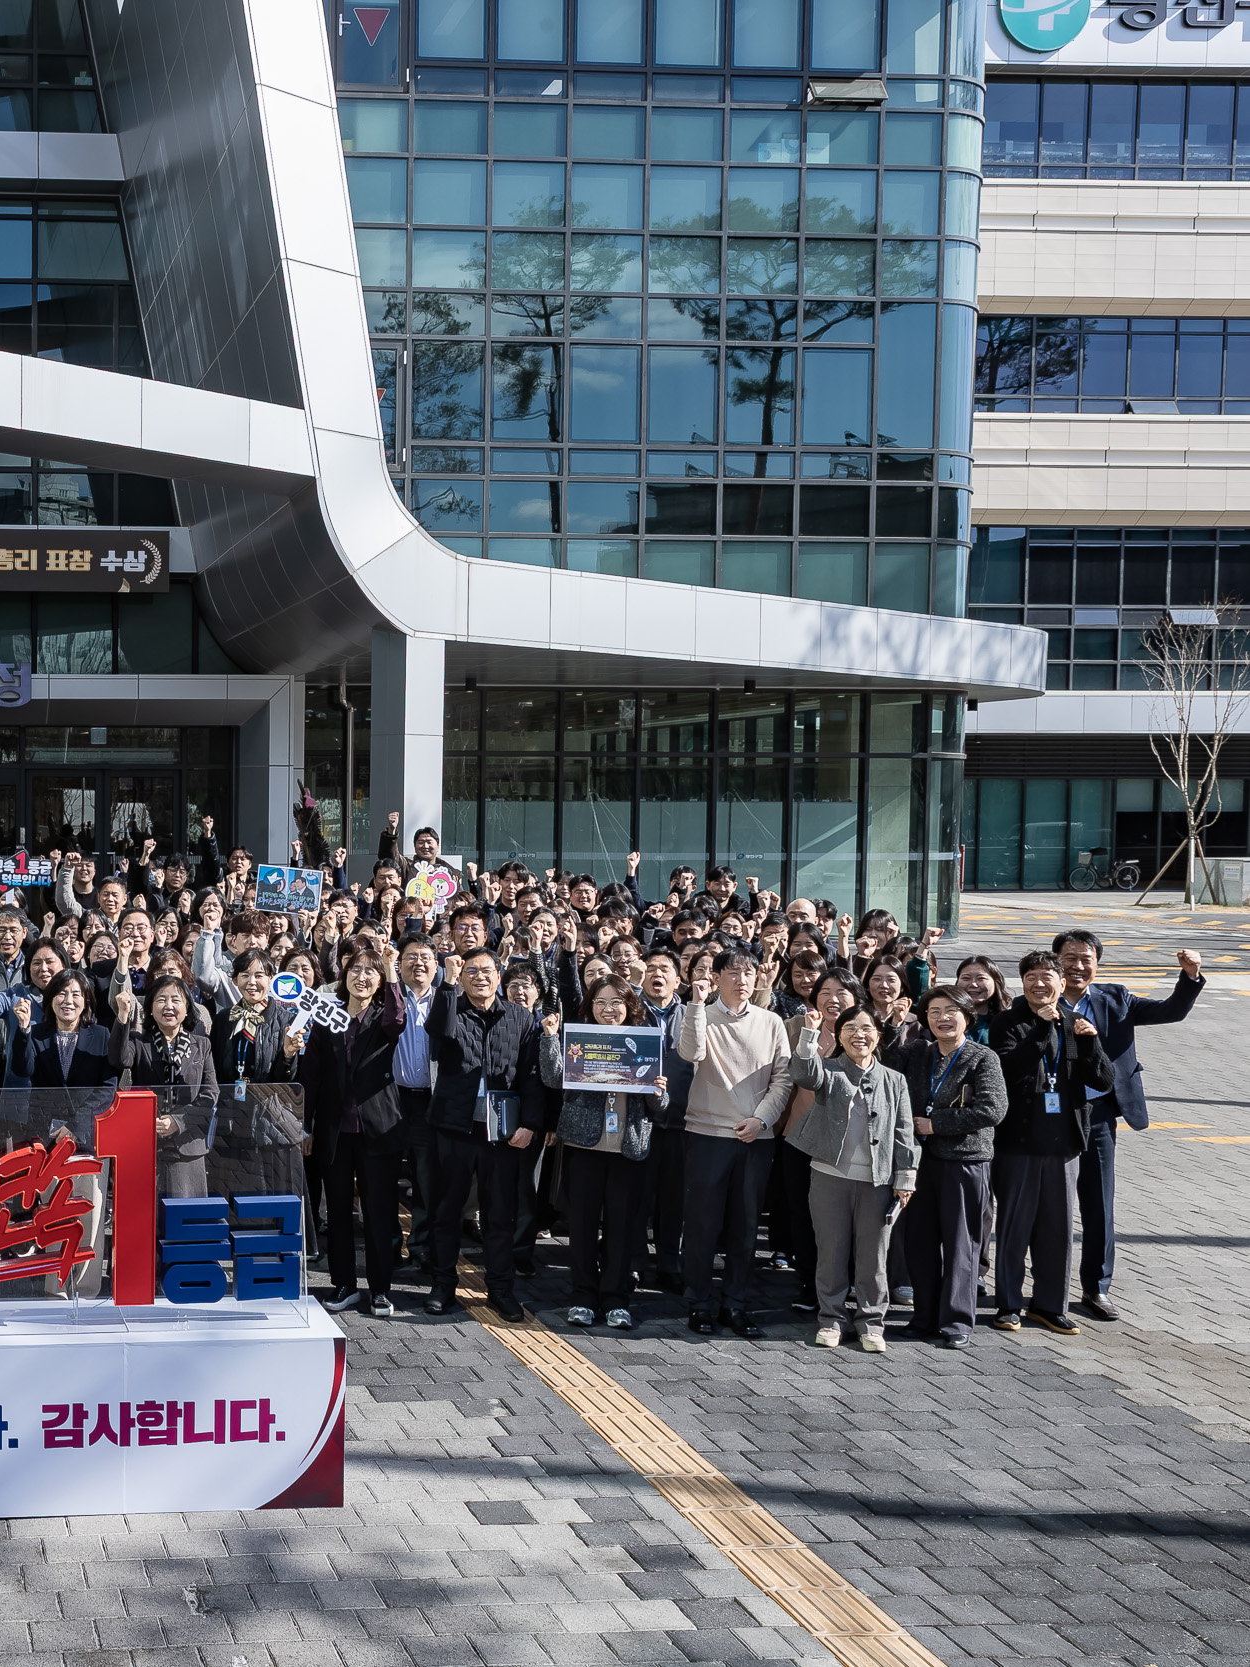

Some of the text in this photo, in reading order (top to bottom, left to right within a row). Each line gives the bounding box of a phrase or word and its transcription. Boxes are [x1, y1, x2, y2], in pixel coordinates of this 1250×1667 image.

[45, 549, 93, 572] 표창
[100, 550, 147, 572] 수상
[1, 873, 52, 887] 덕분입니다
[299, 989, 348, 1030] 광진구
[41, 1398, 286, 1449] 감사합니다.
